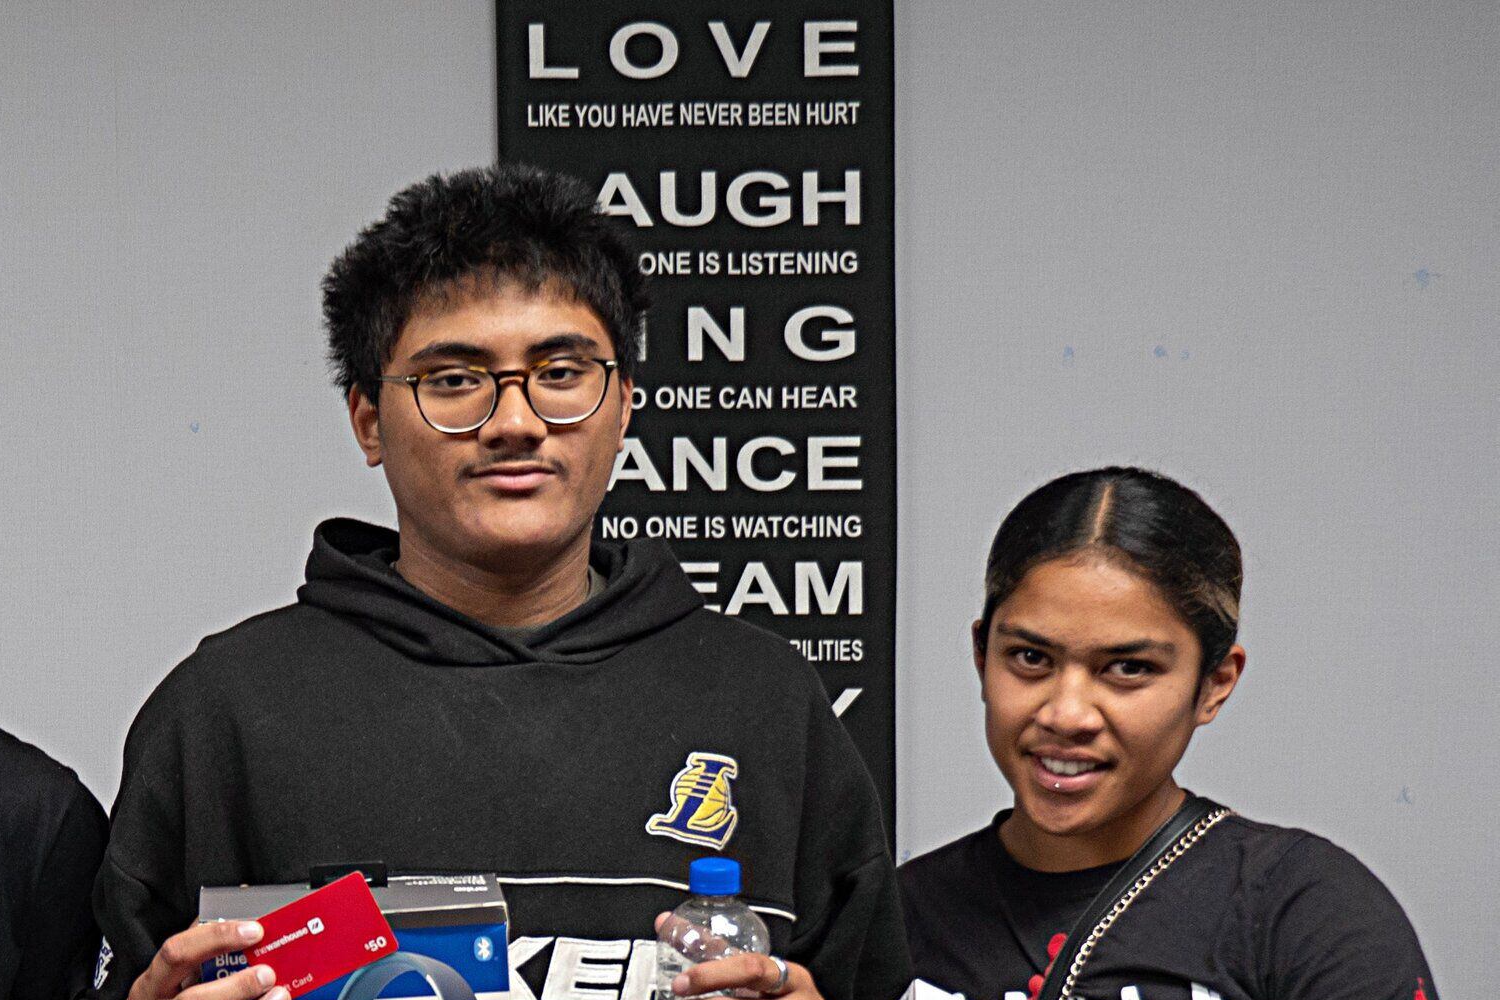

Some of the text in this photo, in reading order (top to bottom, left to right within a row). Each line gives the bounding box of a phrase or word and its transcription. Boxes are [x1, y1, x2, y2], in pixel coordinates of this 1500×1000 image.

[528, 21, 860, 79] LOVE
[527, 101, 860, 127] LIKE YOU HAVE NEVER BEEN HURT
[595, 170, 861, 228] AUGH
[640, 251, 858, 275] ONE IS LISTENING
[636, 305, 856, 362] ING
[631, 386, 857, 410] O ONE CAN HEAR
[607, 436, 863, 493] ANCE
[602, 515, 863, 539] NO ONE IS WATCHING
[679, 560, 863, 616] EAM
[795, 639, 863, 662] ILITIES
[364, 935, 388, 952] $50
[215, 952, 248, 967] Blue
[292, 973, 314, 988] Card
